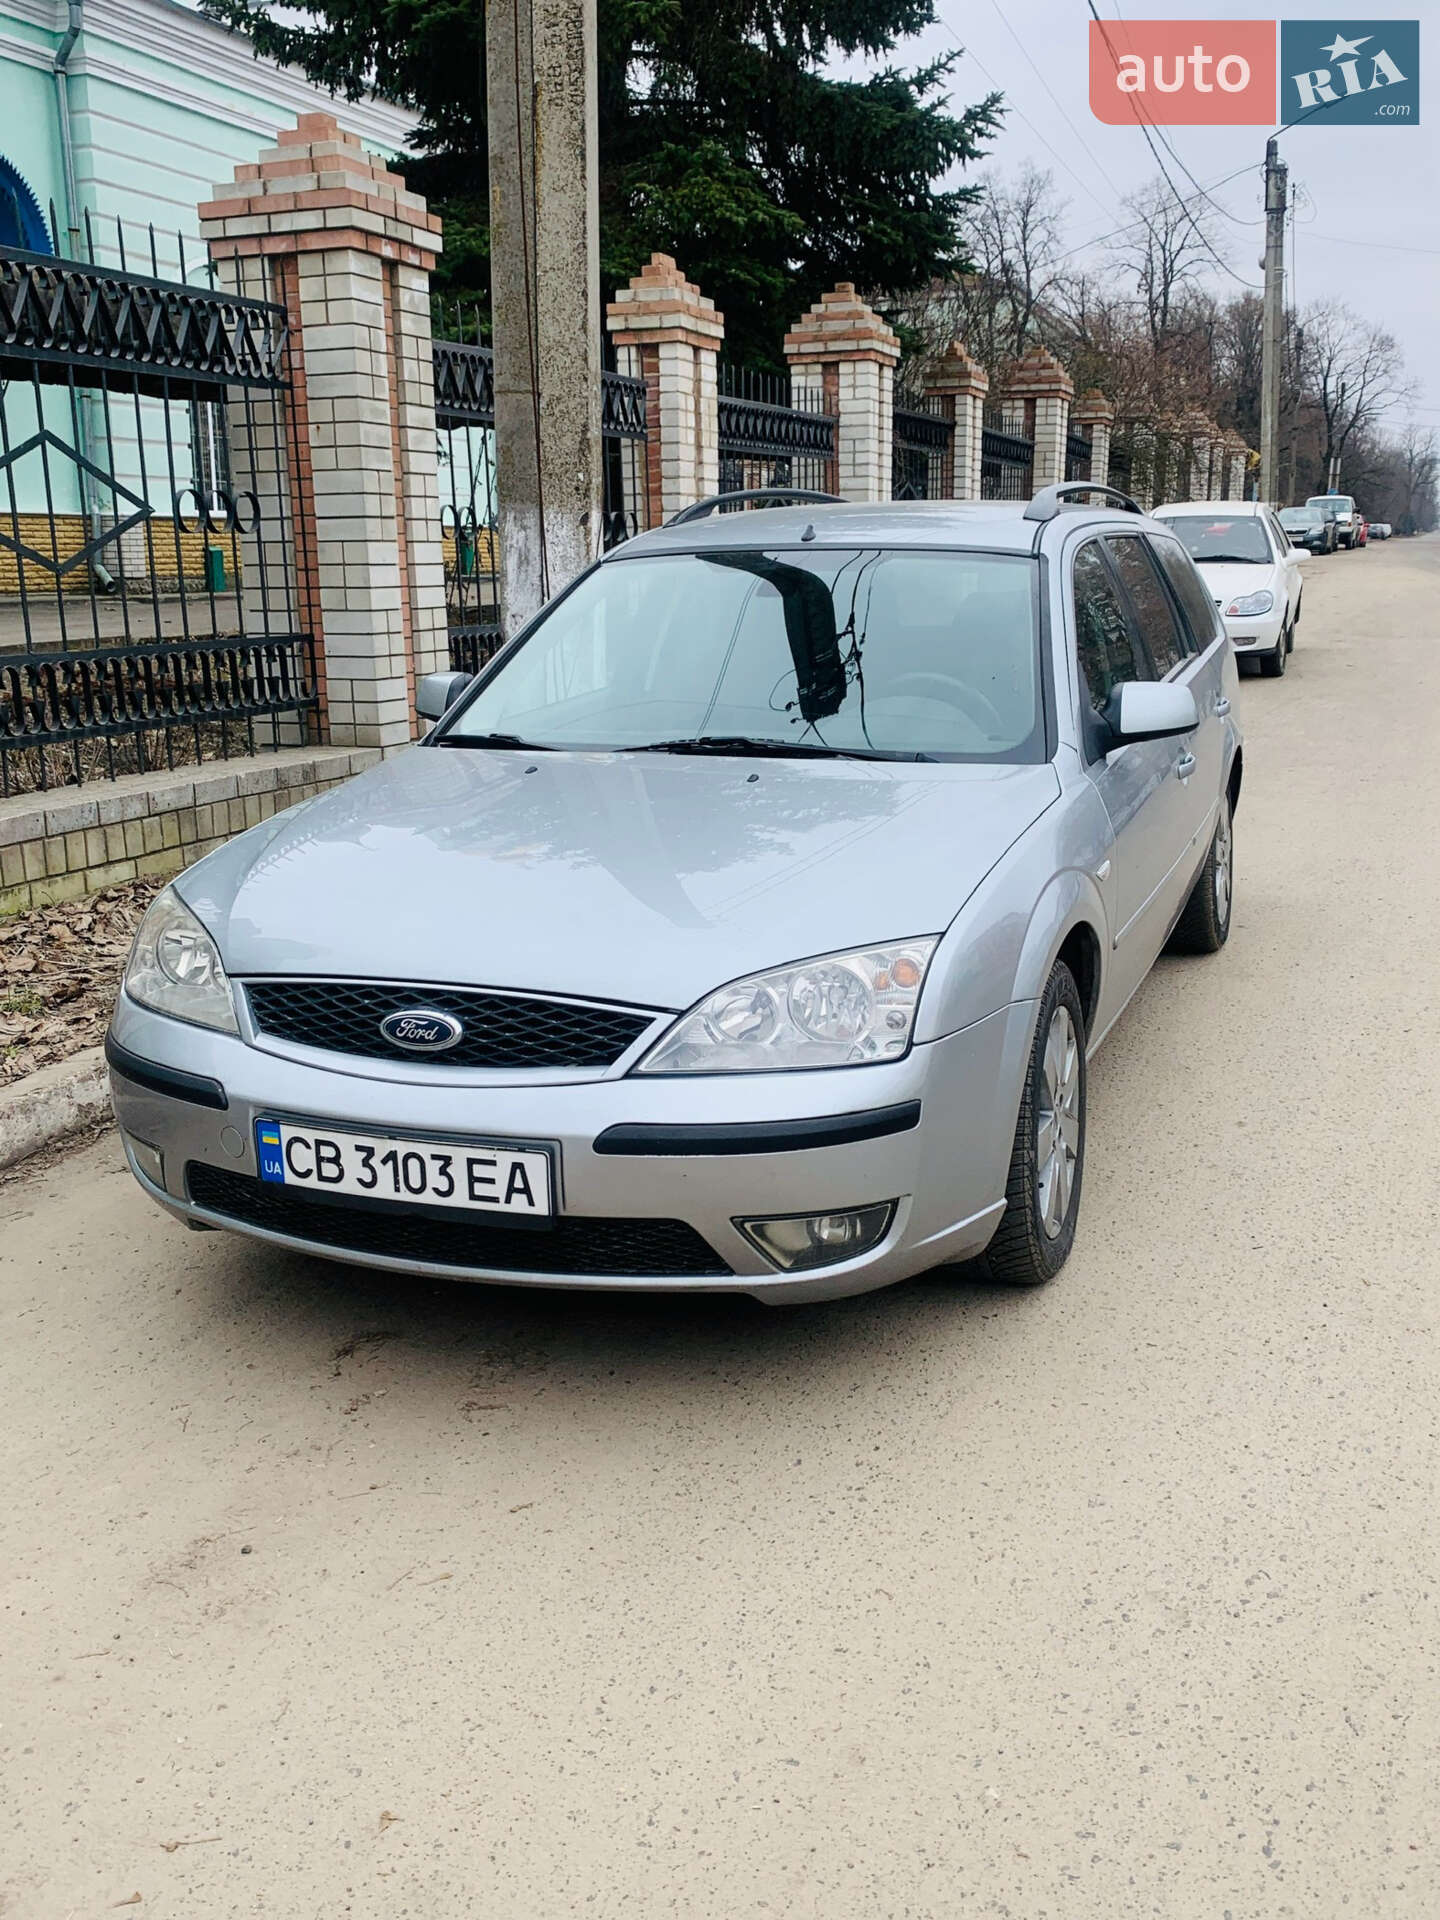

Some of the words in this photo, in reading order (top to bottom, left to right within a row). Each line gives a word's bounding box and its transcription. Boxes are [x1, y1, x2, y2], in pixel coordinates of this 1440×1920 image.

[396, 1018, 440, 1041] Ford
[264, 1159, 282, 1175] UA
[354, 1144, 455, 1198] 3103
